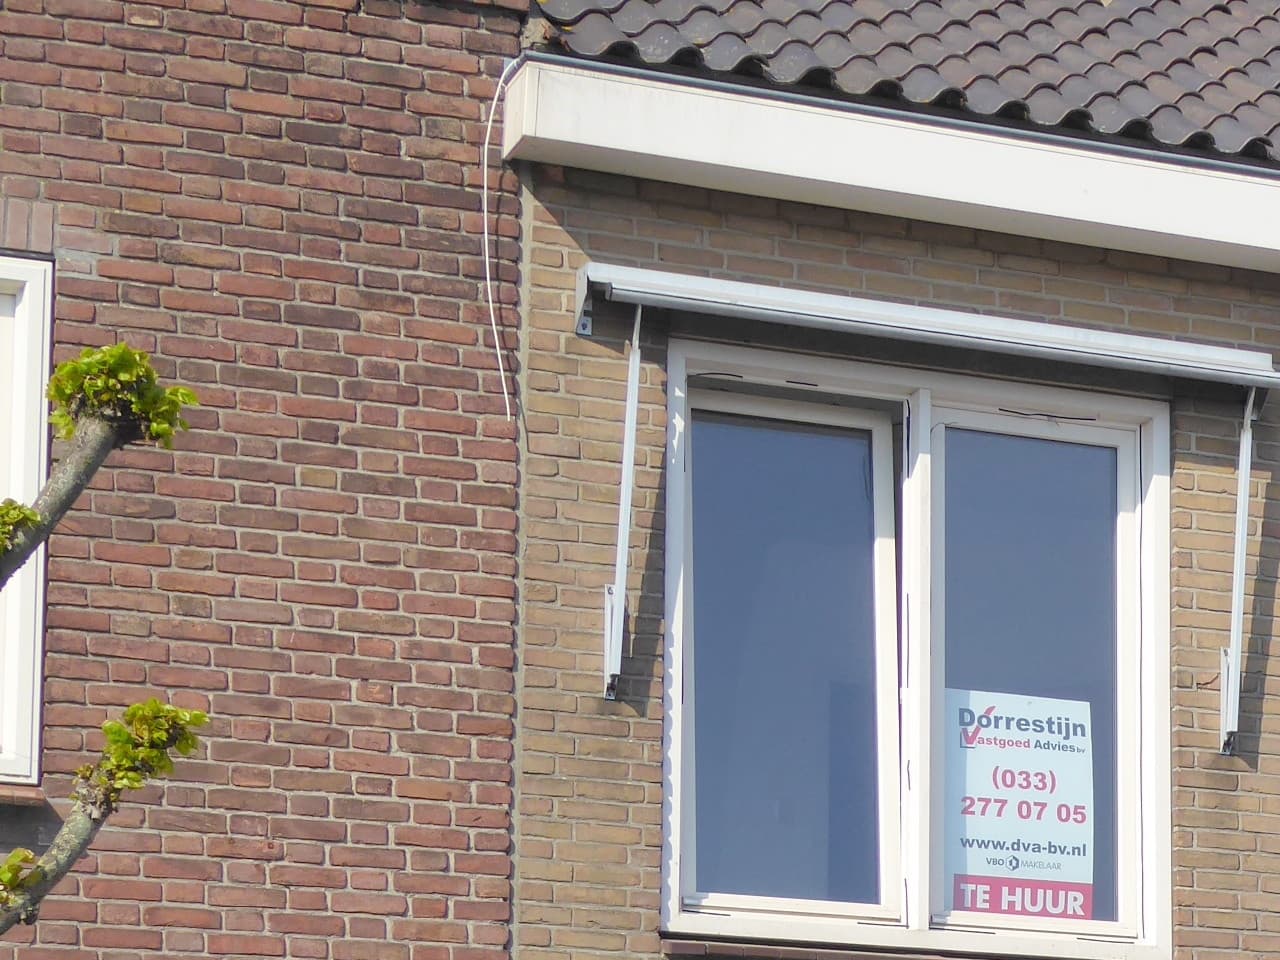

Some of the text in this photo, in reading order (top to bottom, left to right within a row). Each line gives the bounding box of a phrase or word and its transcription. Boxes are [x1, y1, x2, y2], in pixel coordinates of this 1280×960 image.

[958, 707, 1086, 741] Dorrestijn
[960, 725, 1031, 749] Vastgoed
[1034, 740, 1076, 753] Advies
[992, 766, 1056, 794] (033)
[960, 796, 1087, 824] 277 07 05
[960, 838, 1087, 857] www.dva-bv.nl
[986, 857, 1062, 870] VBO MAKELAAR
[960, 883, 1085, 916] TE HUUR
